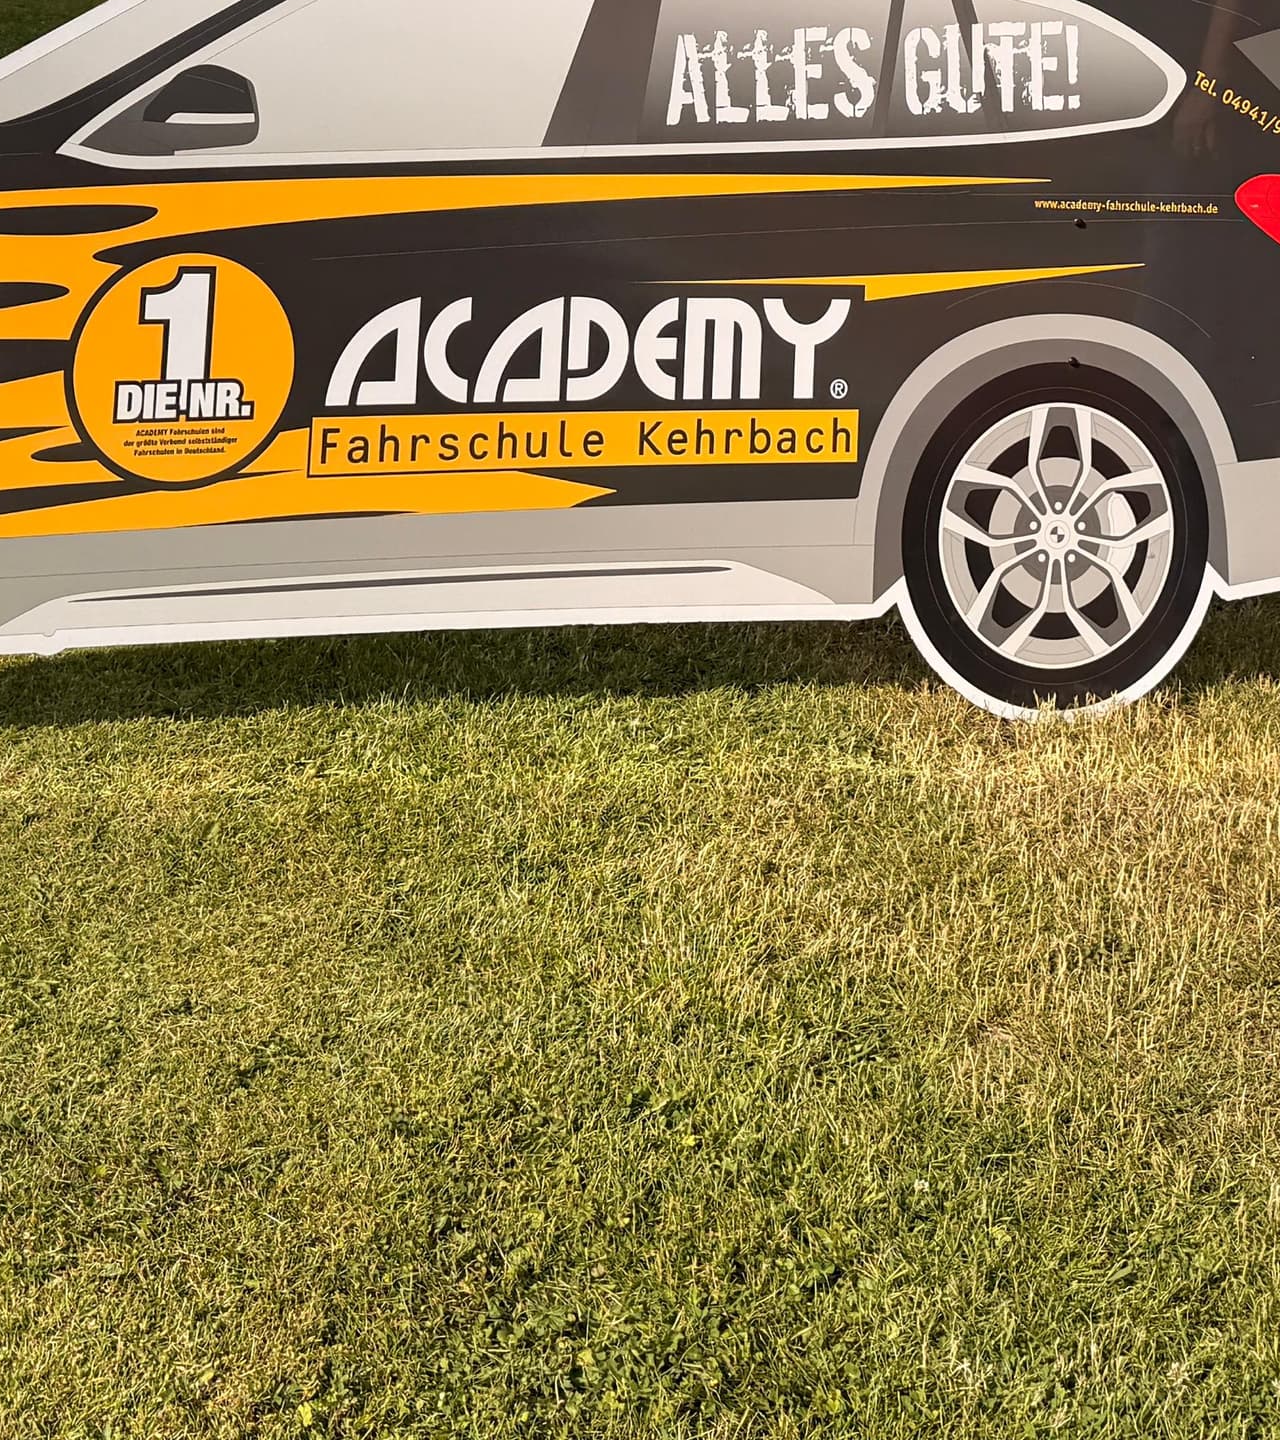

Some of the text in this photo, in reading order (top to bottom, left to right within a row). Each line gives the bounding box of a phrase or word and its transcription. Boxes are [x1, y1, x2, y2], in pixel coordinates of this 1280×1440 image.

[666, 20, 1080, 126] ALLES GUTE!
[1194, 70, 1217, 97] Tel.
[1033, 199, 1219, 215] www.academy-fahrschule-kehrbach.de
[138, 266, 217, 381] 1
[115, 381, 252, 421] DIE NR.
[320, 418, 852, 464] Fahrschule Kehrbach
